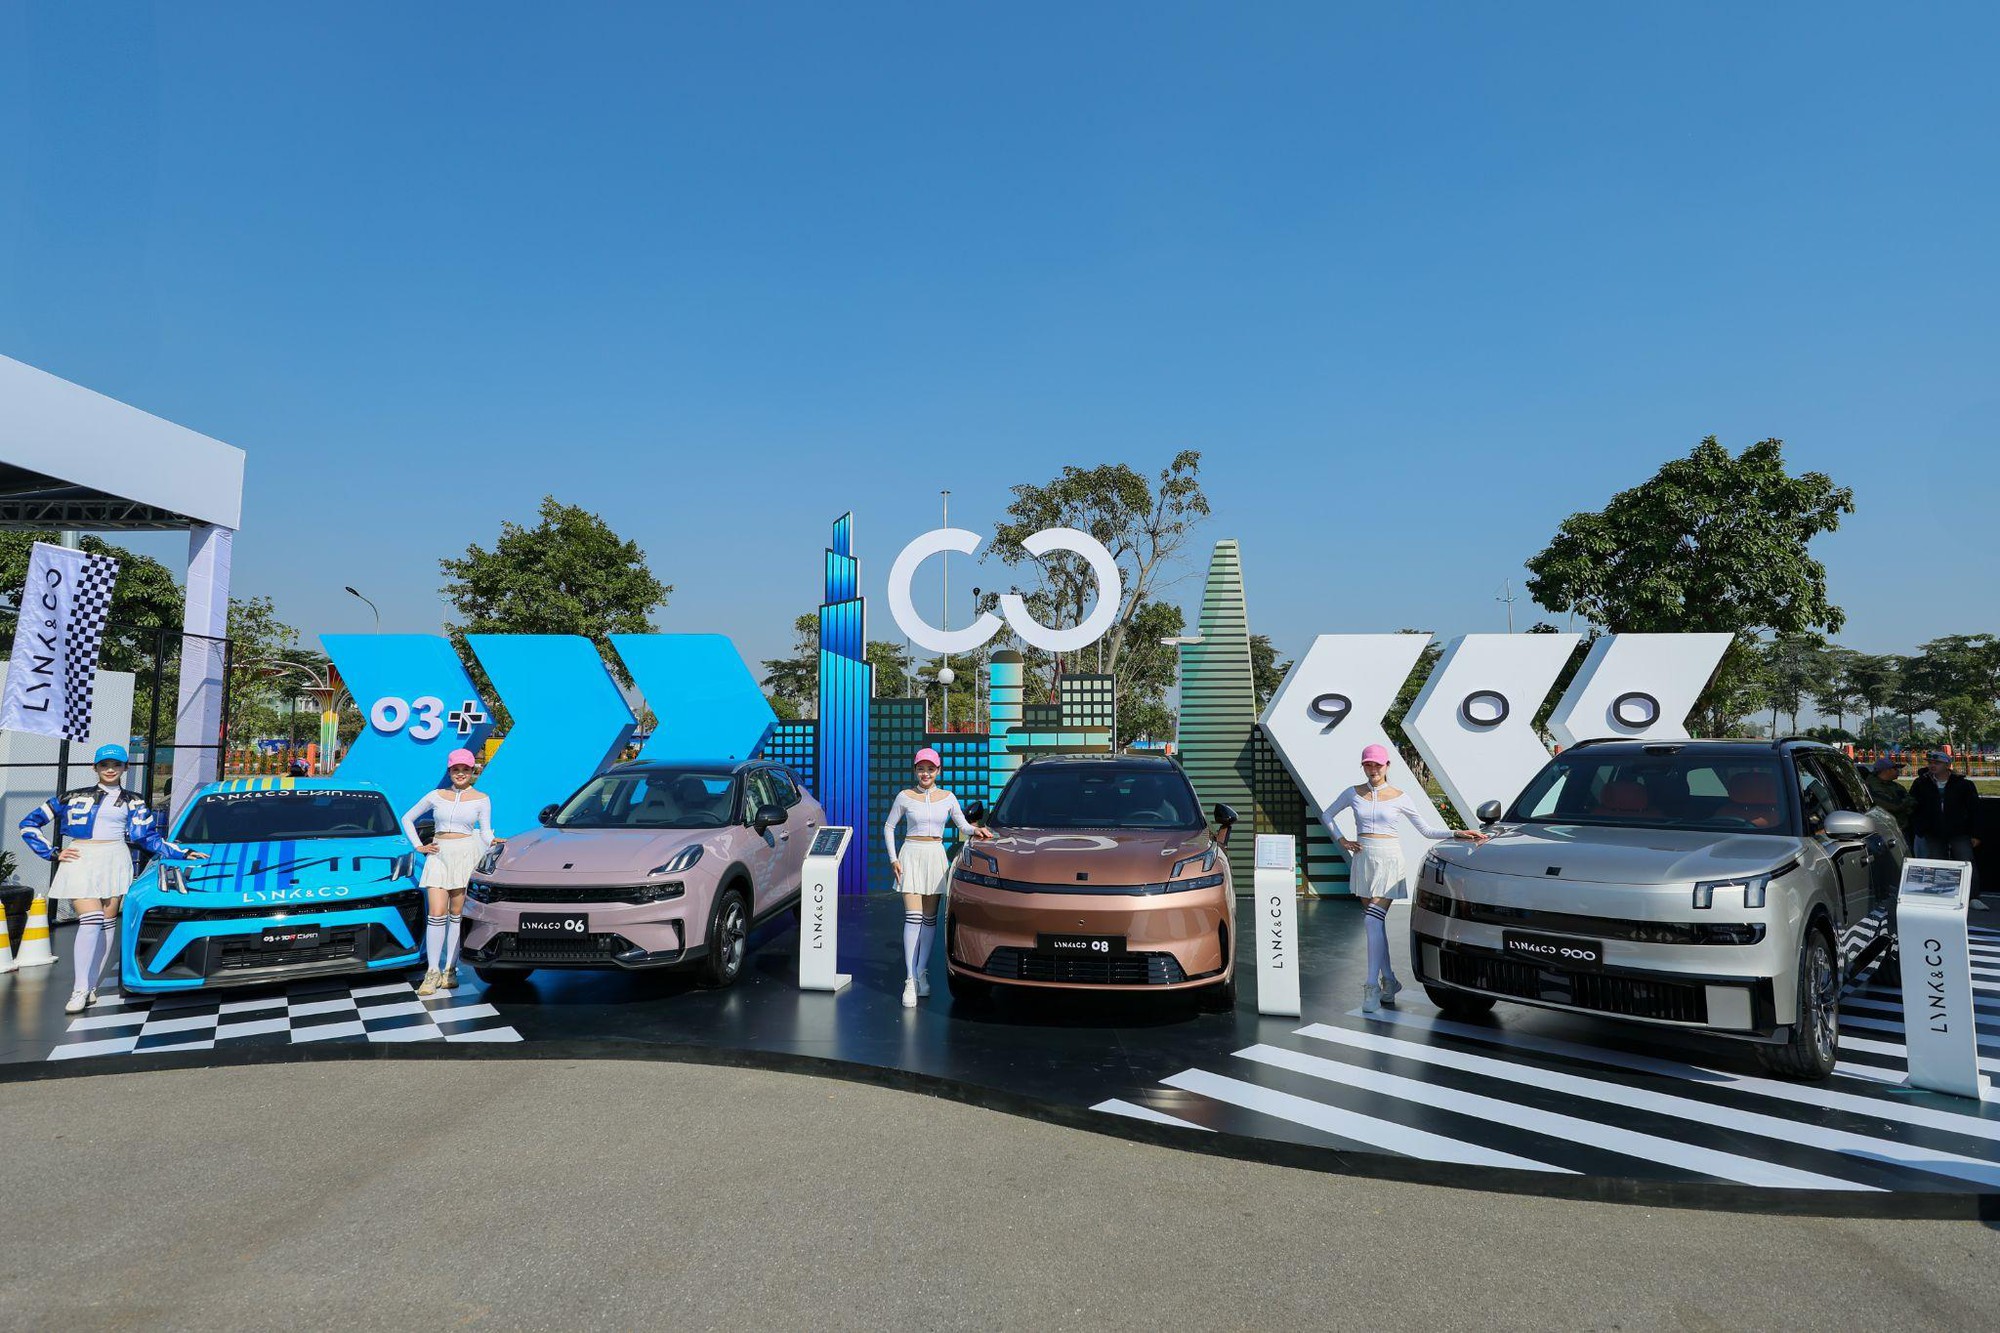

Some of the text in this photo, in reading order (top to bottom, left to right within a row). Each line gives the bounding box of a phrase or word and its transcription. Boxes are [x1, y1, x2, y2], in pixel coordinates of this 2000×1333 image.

[23, 568, 62, 712] LYNK&CO
[206, 790, 290, 803] LYNK&CO
[243, 886, 349, 903] LYNK&CO
[522, 919, 585, 933] LYNK&CO 06
[813, 883, 823, 949] LYNK&CO
[1270, 896, 1283, 968] LYNK&CO
[1054, 940, 1109, 953] LYNK&CO 08
[1509, 940, 1596, 961] LYNK&CO 900
[1924, 938, 1948, 1033] LYNK&CO
